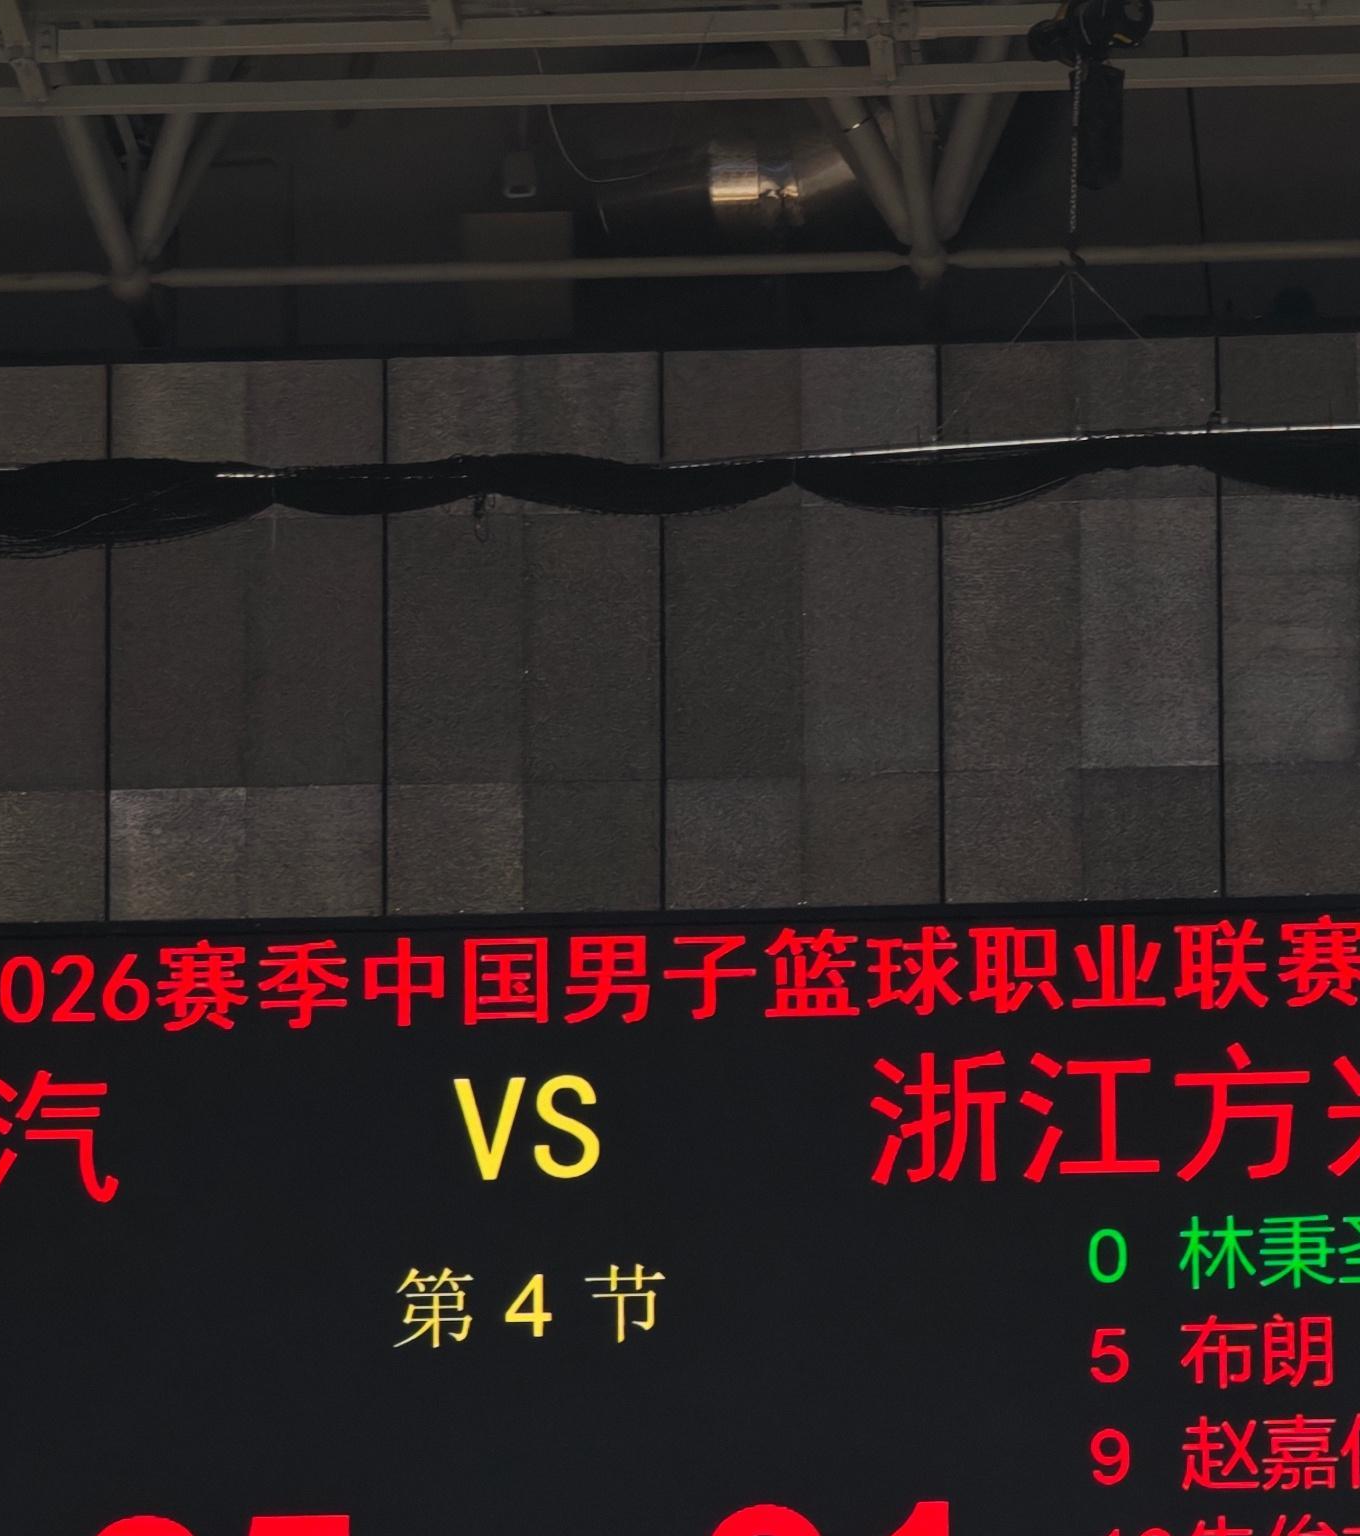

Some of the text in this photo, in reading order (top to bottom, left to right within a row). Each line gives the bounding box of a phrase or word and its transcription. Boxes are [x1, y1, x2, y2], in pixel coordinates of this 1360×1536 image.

[454, 1074, 600, 1181] VS
[1088, 1228, 1128, 1284] 0
[1090, 1327, 1130, 1384] 5
[1180, 1313, 1334, 1390] 布朗
[1089, 1427, 1131, 1486] 9
